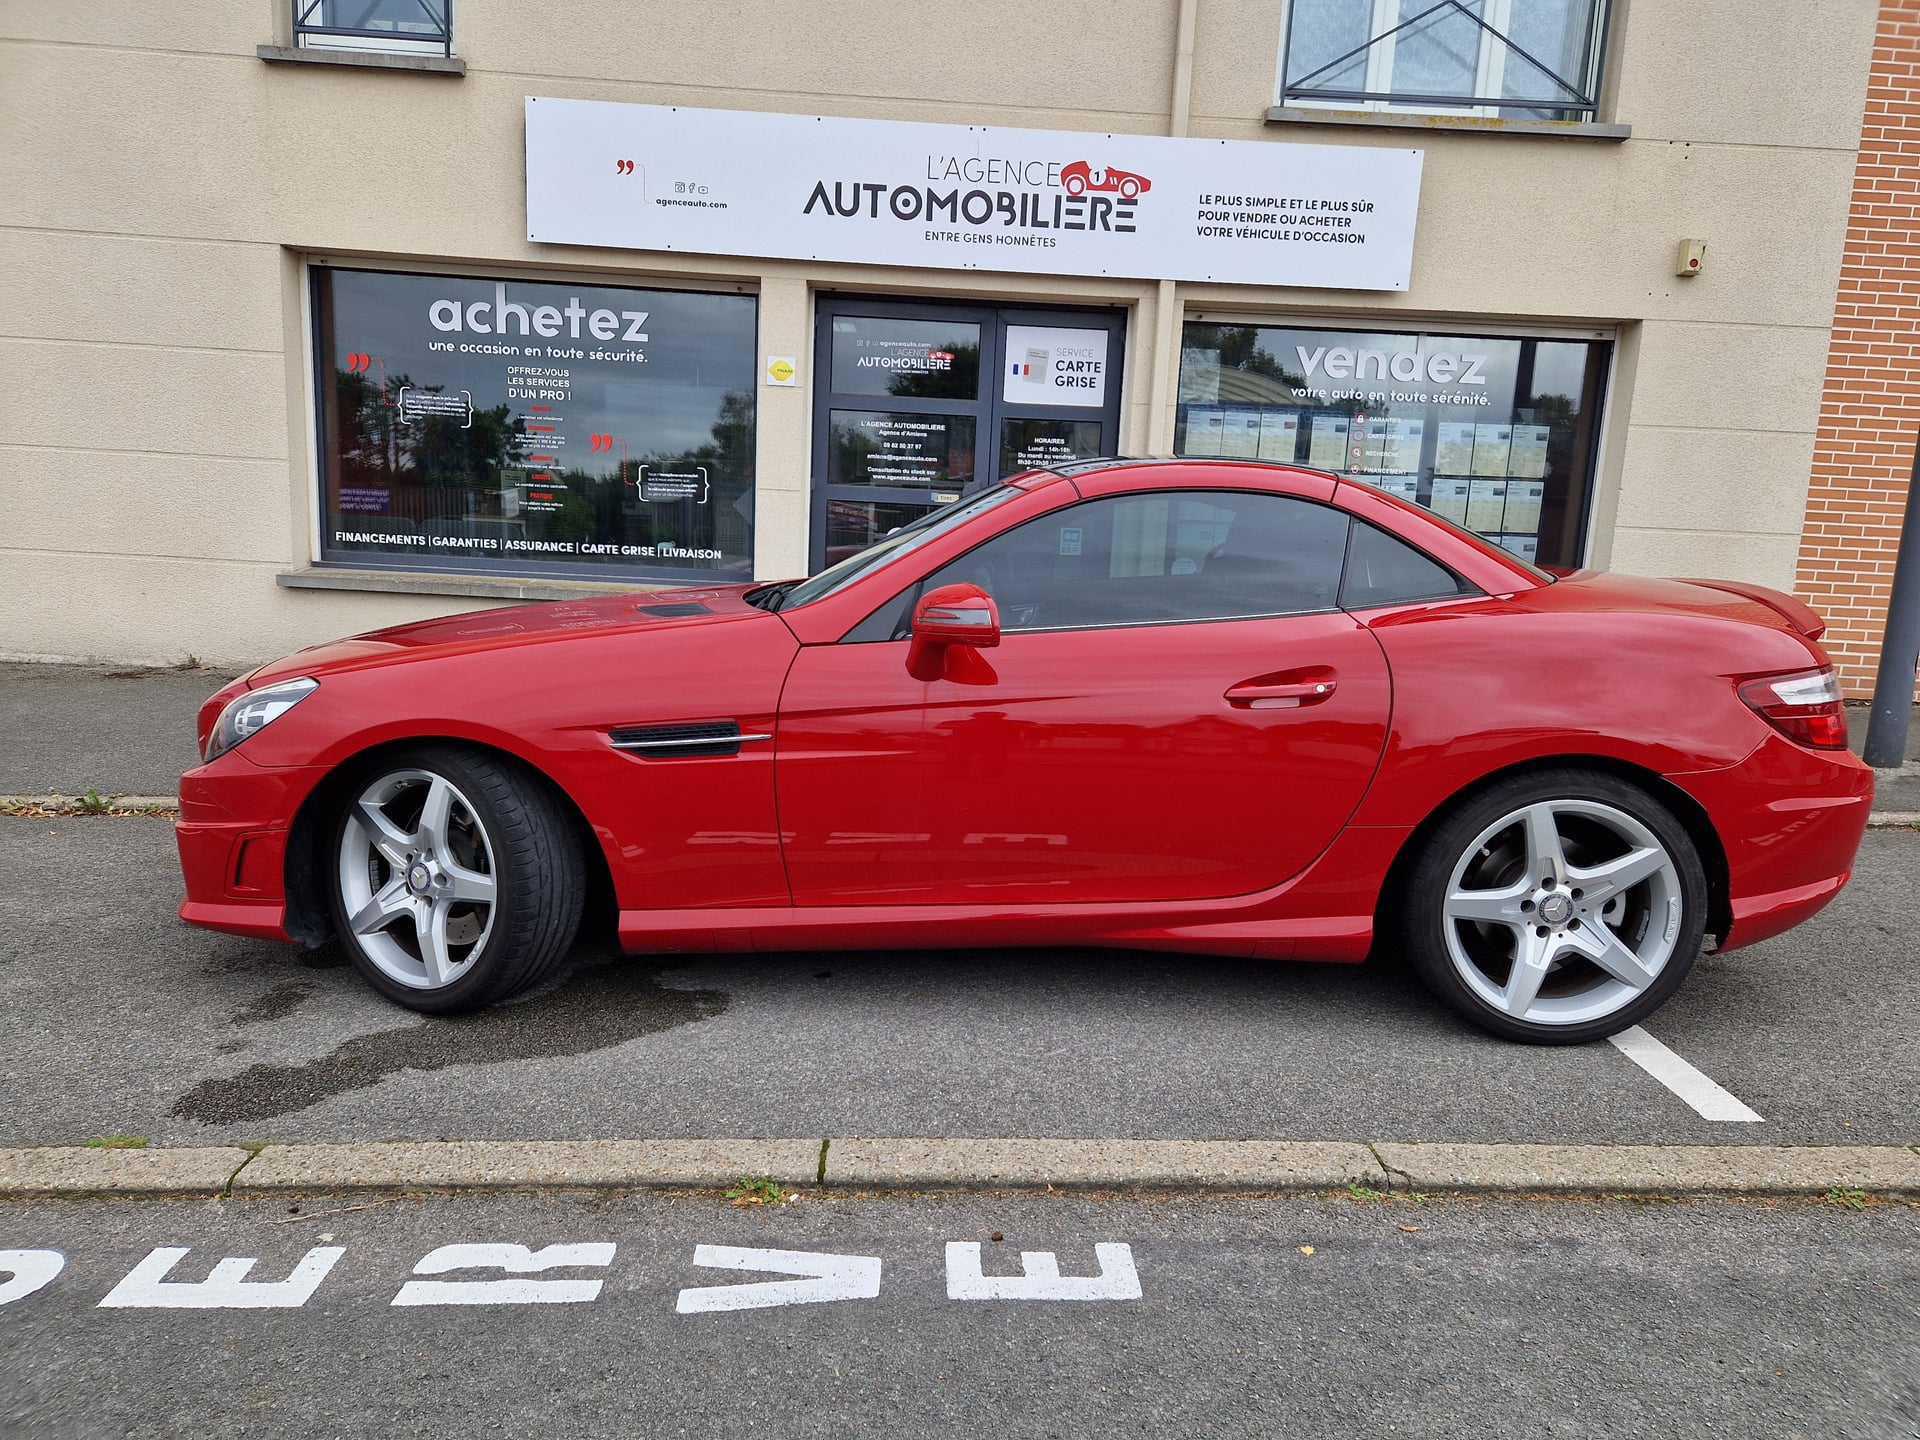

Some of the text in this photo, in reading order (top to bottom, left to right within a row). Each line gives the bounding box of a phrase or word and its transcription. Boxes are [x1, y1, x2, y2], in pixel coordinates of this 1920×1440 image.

[928, 155, 1062, 187] L'AGENCE
[656, 198, 727, 209] agenceauto.com
[1200, 194, 1374, 213] LE PLUS SIMPLE ET LE PLUS SÛR
[1198, 210, 1351, 228] POUR VENDRE OU ACHETER
[926, 231, 1056, 248] ENTRE GENS HONNÊTES
[1197, 226, 1365, 244] VOTRE VÉHICULE D'OCCASION
[428, 283, 649, 343] achetez
[428, 342, 648, 363] une occasion en toute sécurité.
[891, 348, 929, 357] L'AGENCE
[1056, 348, 1093, 358] SERVICE
[1296, 333, 1489, 386] vendez
[507, 366, 570, 377] OFFREZ-VOUS
[1055, 360, 1101, 374] CARTE
[507, 377, 570, 388] LES SERVICES
[1054, 375, 1096, 388] GRISE
[509, 388, 537, 400] D'UN
[540, 389, 564, 401] PRO
[1291, 388, 1491, 406] votre auto en toute sérénité.
[336, 532, 721, 560] FINANCEMENTS GARANTIES ASSURANCE CARTE GRISE LIVRAISON
